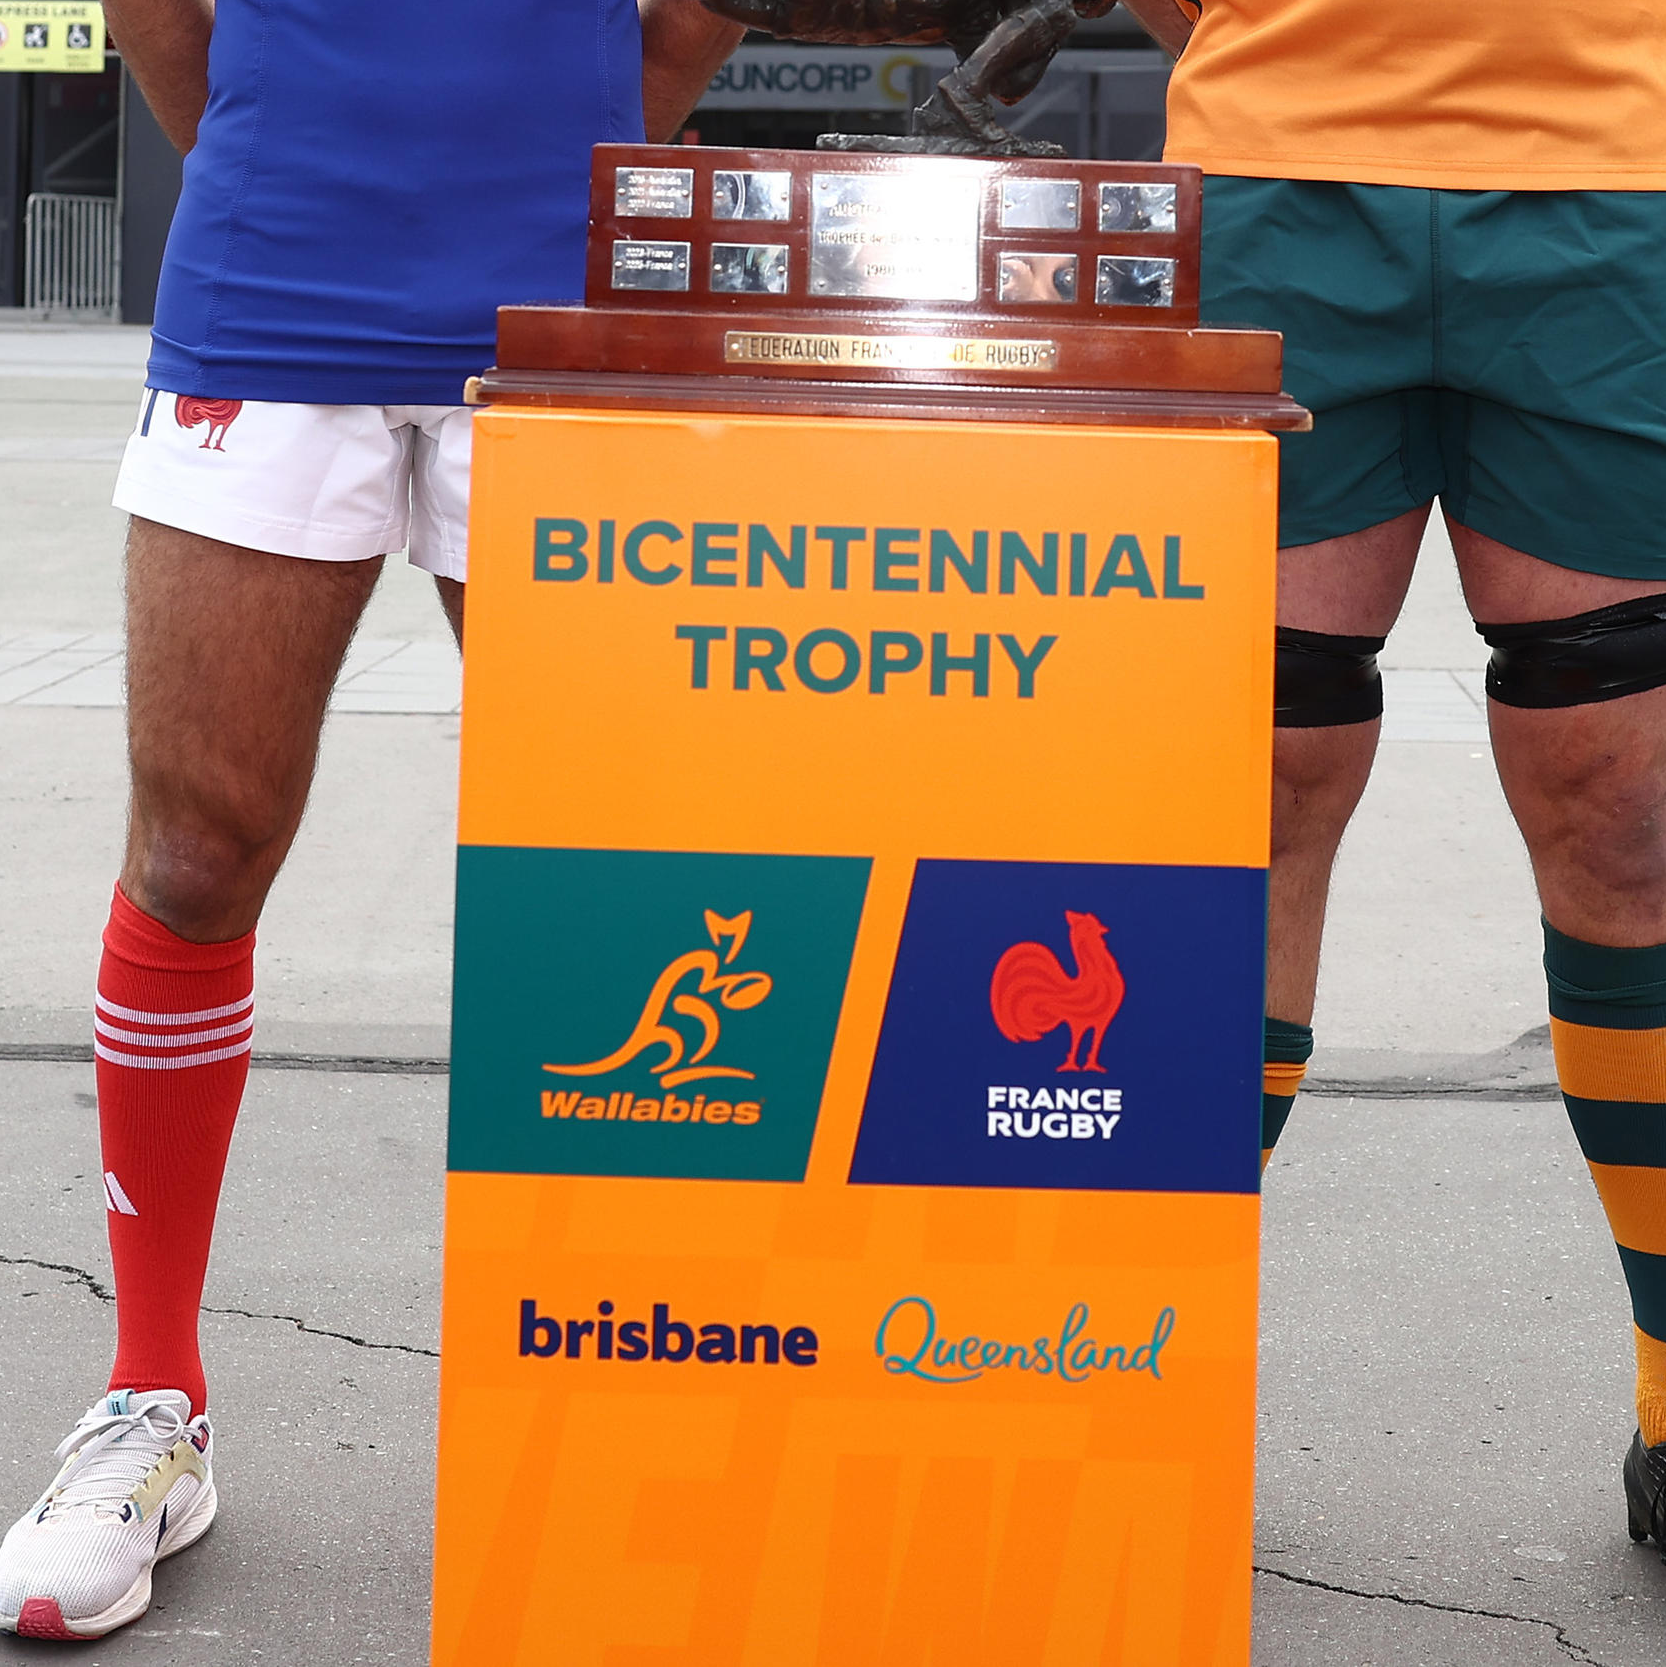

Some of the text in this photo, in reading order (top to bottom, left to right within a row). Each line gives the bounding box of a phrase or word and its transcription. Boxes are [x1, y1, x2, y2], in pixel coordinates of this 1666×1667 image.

[52, 7, 87, 17] LANE
[708, 61, 873, 93] SUNCORP
[985, 344, 1041, 366] RUGBY
[532, 517, 1206, 601] BICENTENNIAL
[675, 625, 1059, 700] TROPHY
[540, 1090, 762, 1125] Wallabies
[987, 1086, 1123, 1112] FRANCE
[987, 1110, 1122, 1140] RUGBY
[519, 1299, 819, 1367] brisbane
[874, 1294, 1177, 1385] Queensland
